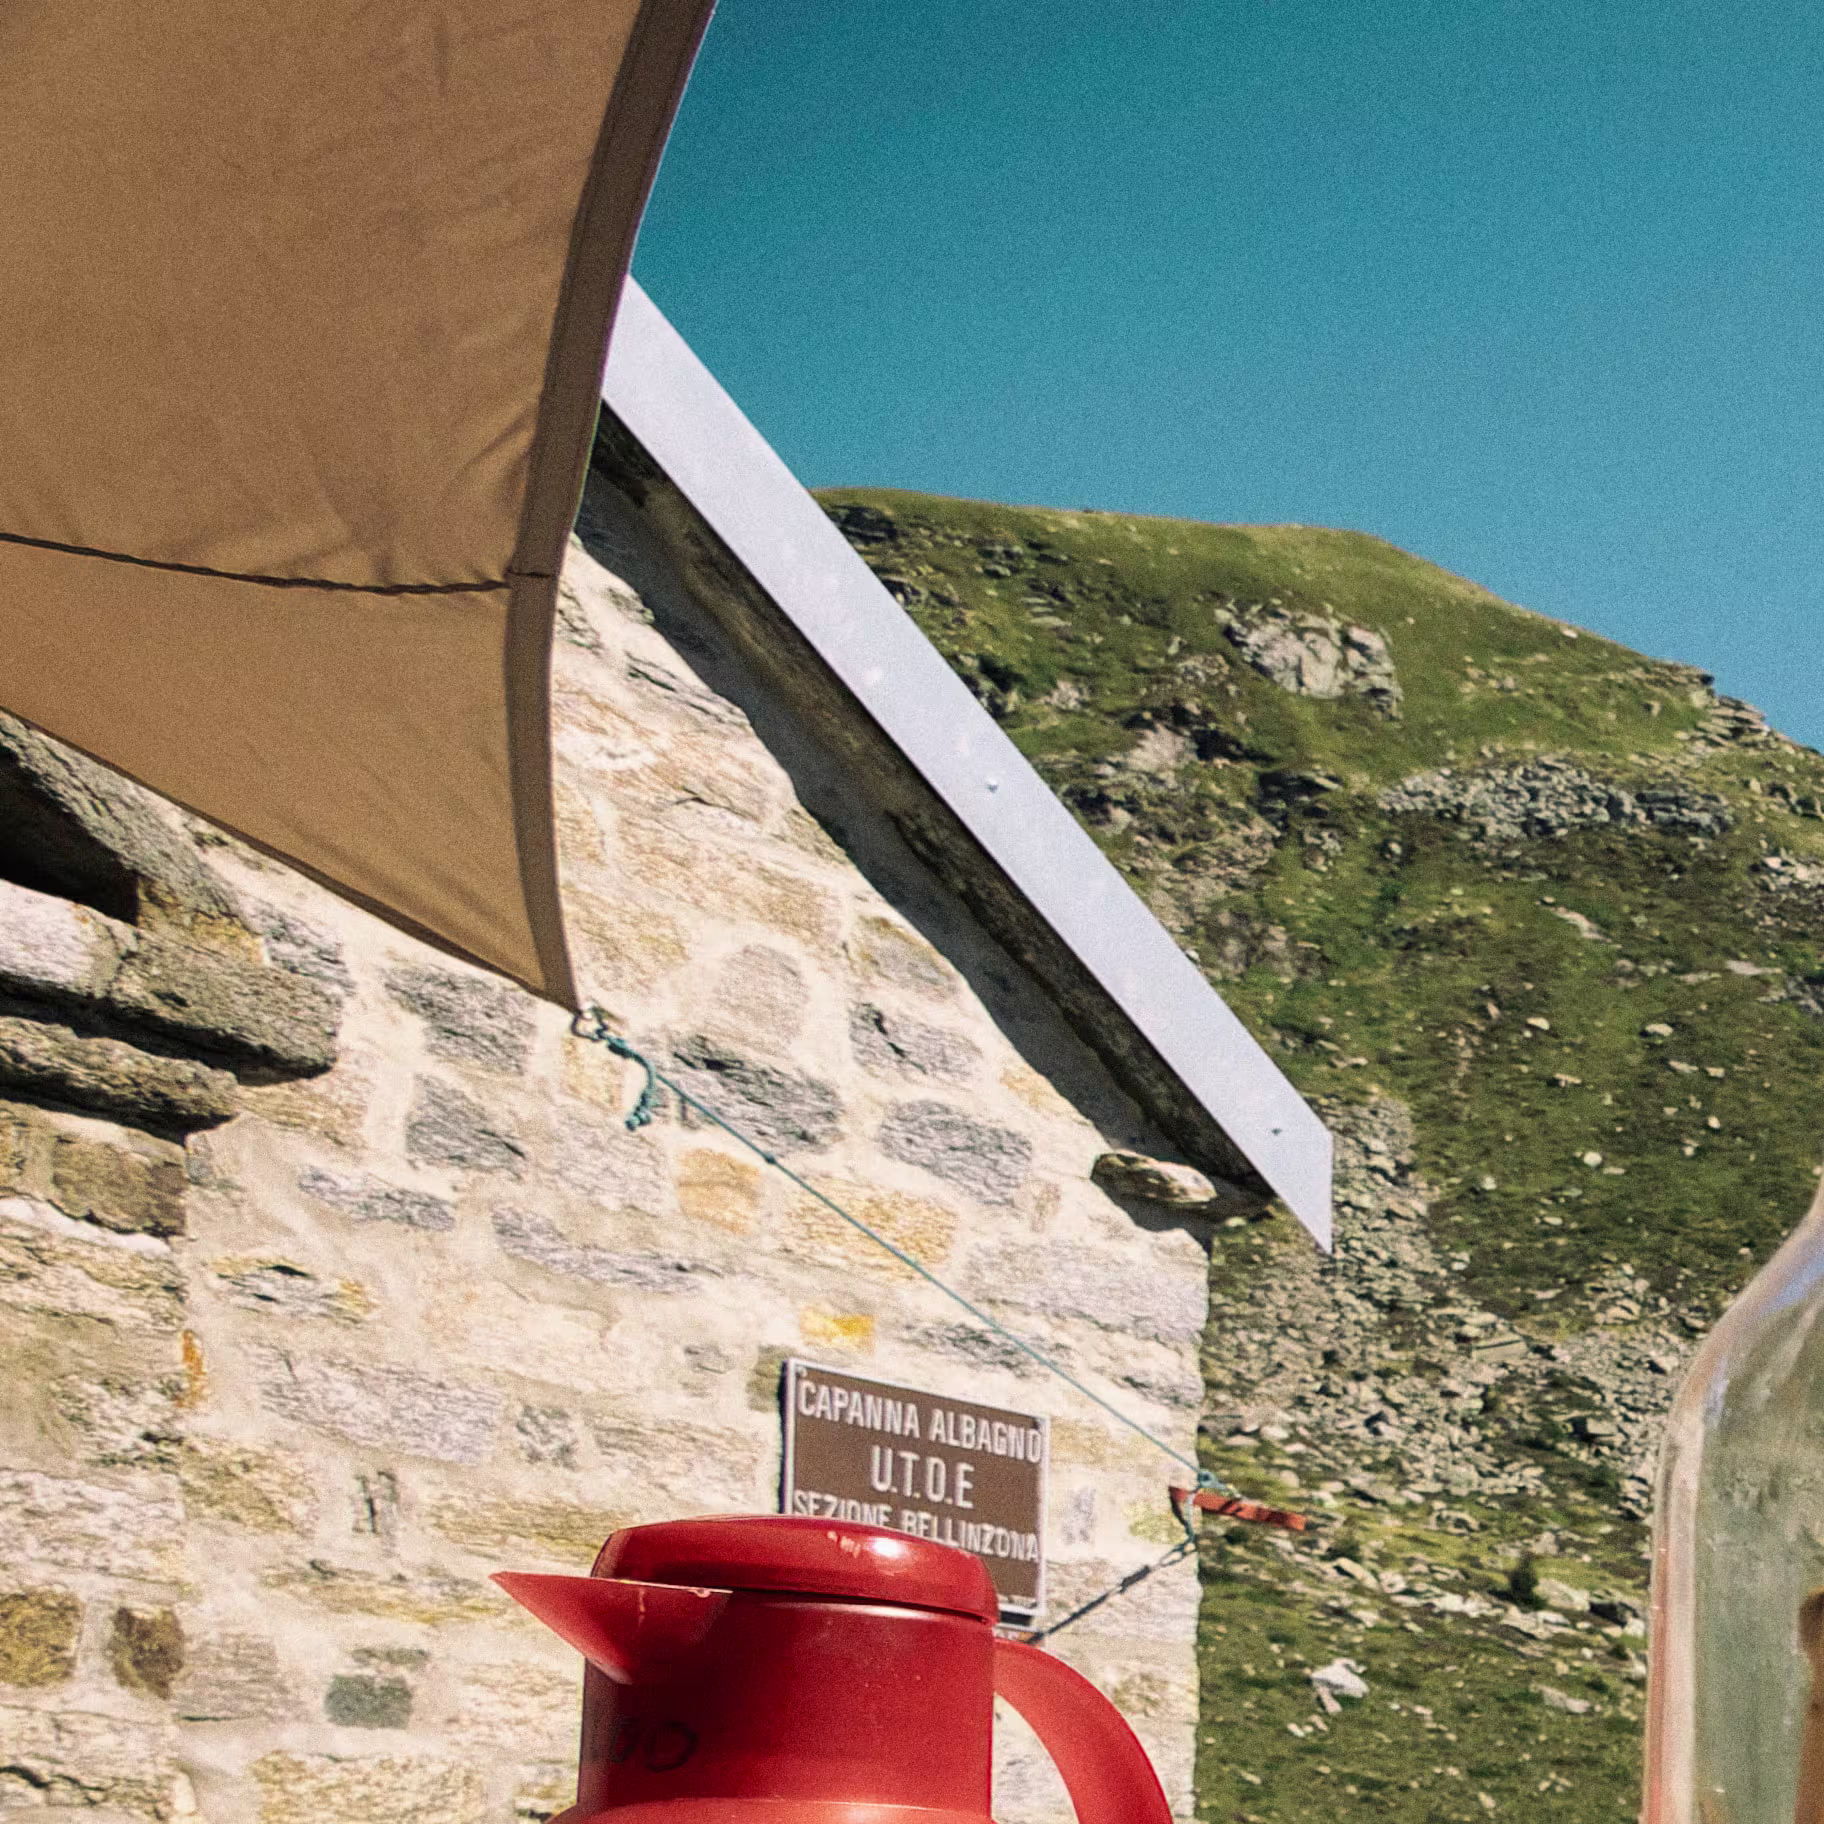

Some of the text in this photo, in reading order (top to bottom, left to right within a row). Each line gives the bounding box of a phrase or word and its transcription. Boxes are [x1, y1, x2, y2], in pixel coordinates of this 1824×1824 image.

[799, 1380, 1042, 1463] CAPANNA ALBAGNO
[793, 1489, 1040, 1563] SEZIONE BELLINZONA
